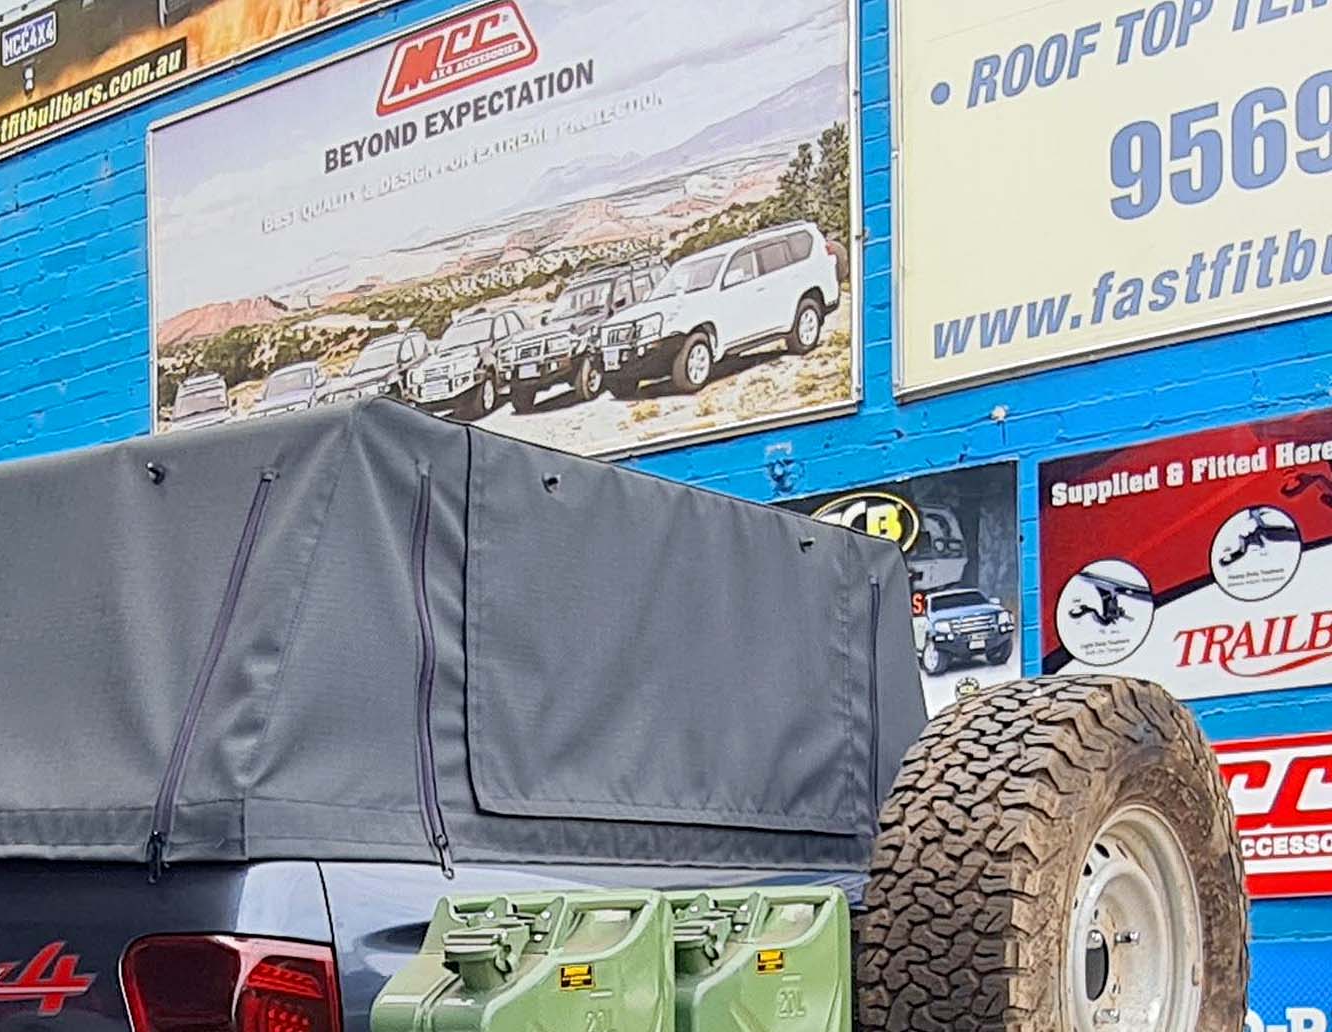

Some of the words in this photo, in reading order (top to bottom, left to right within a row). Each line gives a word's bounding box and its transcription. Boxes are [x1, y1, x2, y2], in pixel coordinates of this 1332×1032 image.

[3, 17, 55, 61] MCC4X4
[389, 13, 519, 97] MCC
[966, 22, 1102, 109] ROOF
[1115, 0, 1214, 65] TOP
[324, 120, 418, 174] BEYOND
[424, 59, 594, 139] EXPECTATION
[1051, 465, 1159, 507] Supplied
[1166, 462, 1184, 488] &
[1191, 446, 1267, 483] Fitted
